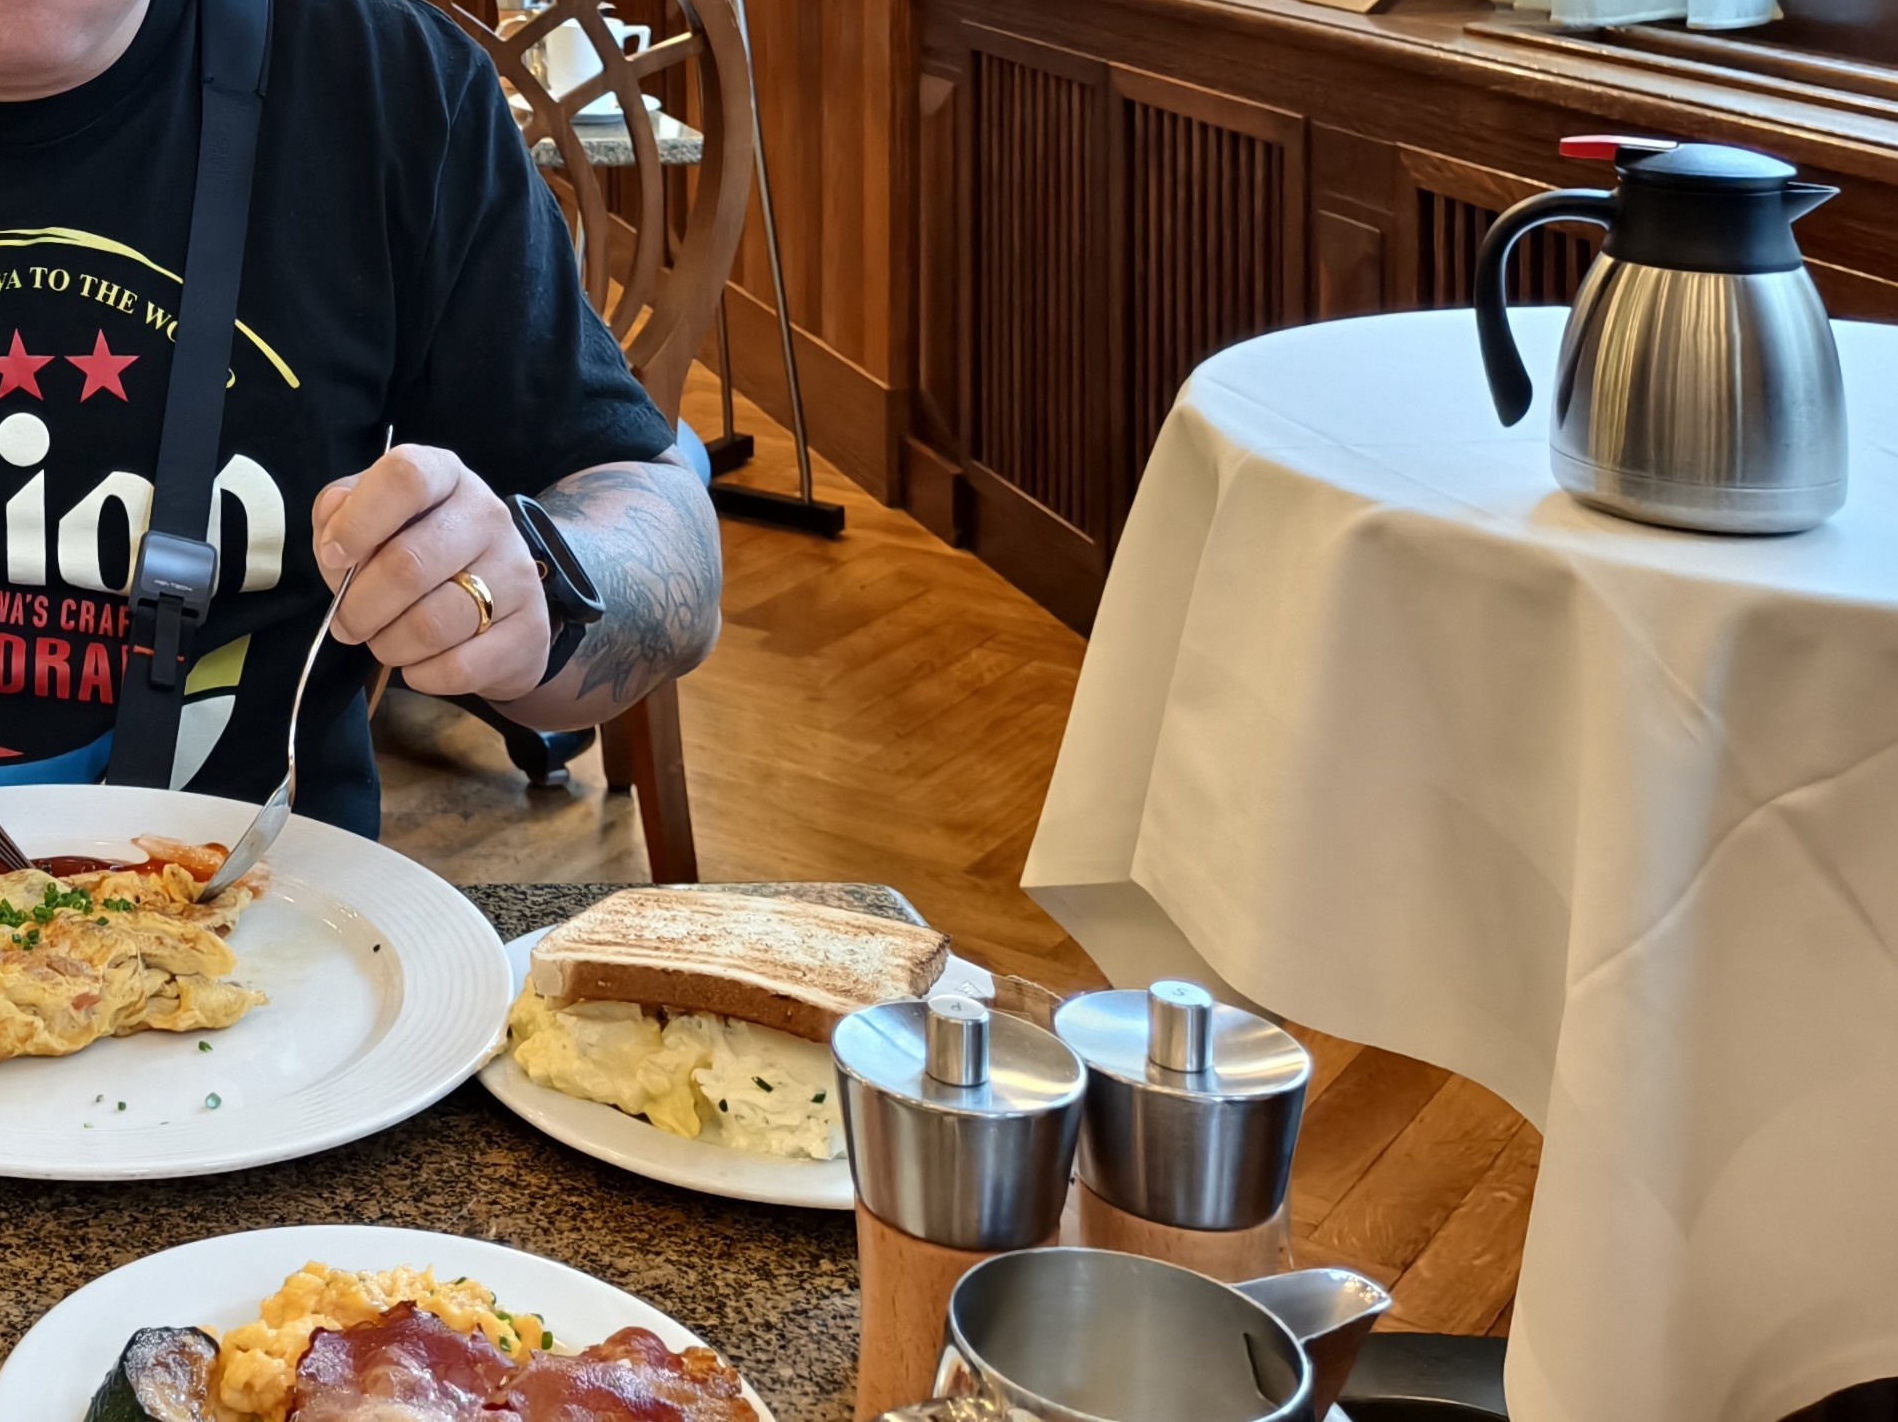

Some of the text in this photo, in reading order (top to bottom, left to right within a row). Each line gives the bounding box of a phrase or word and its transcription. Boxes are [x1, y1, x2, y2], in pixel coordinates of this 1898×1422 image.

[29, 266, 71, 292] TO
[78, 273, 139, 316] THE
[59, 598, 130, 638] CRAF
